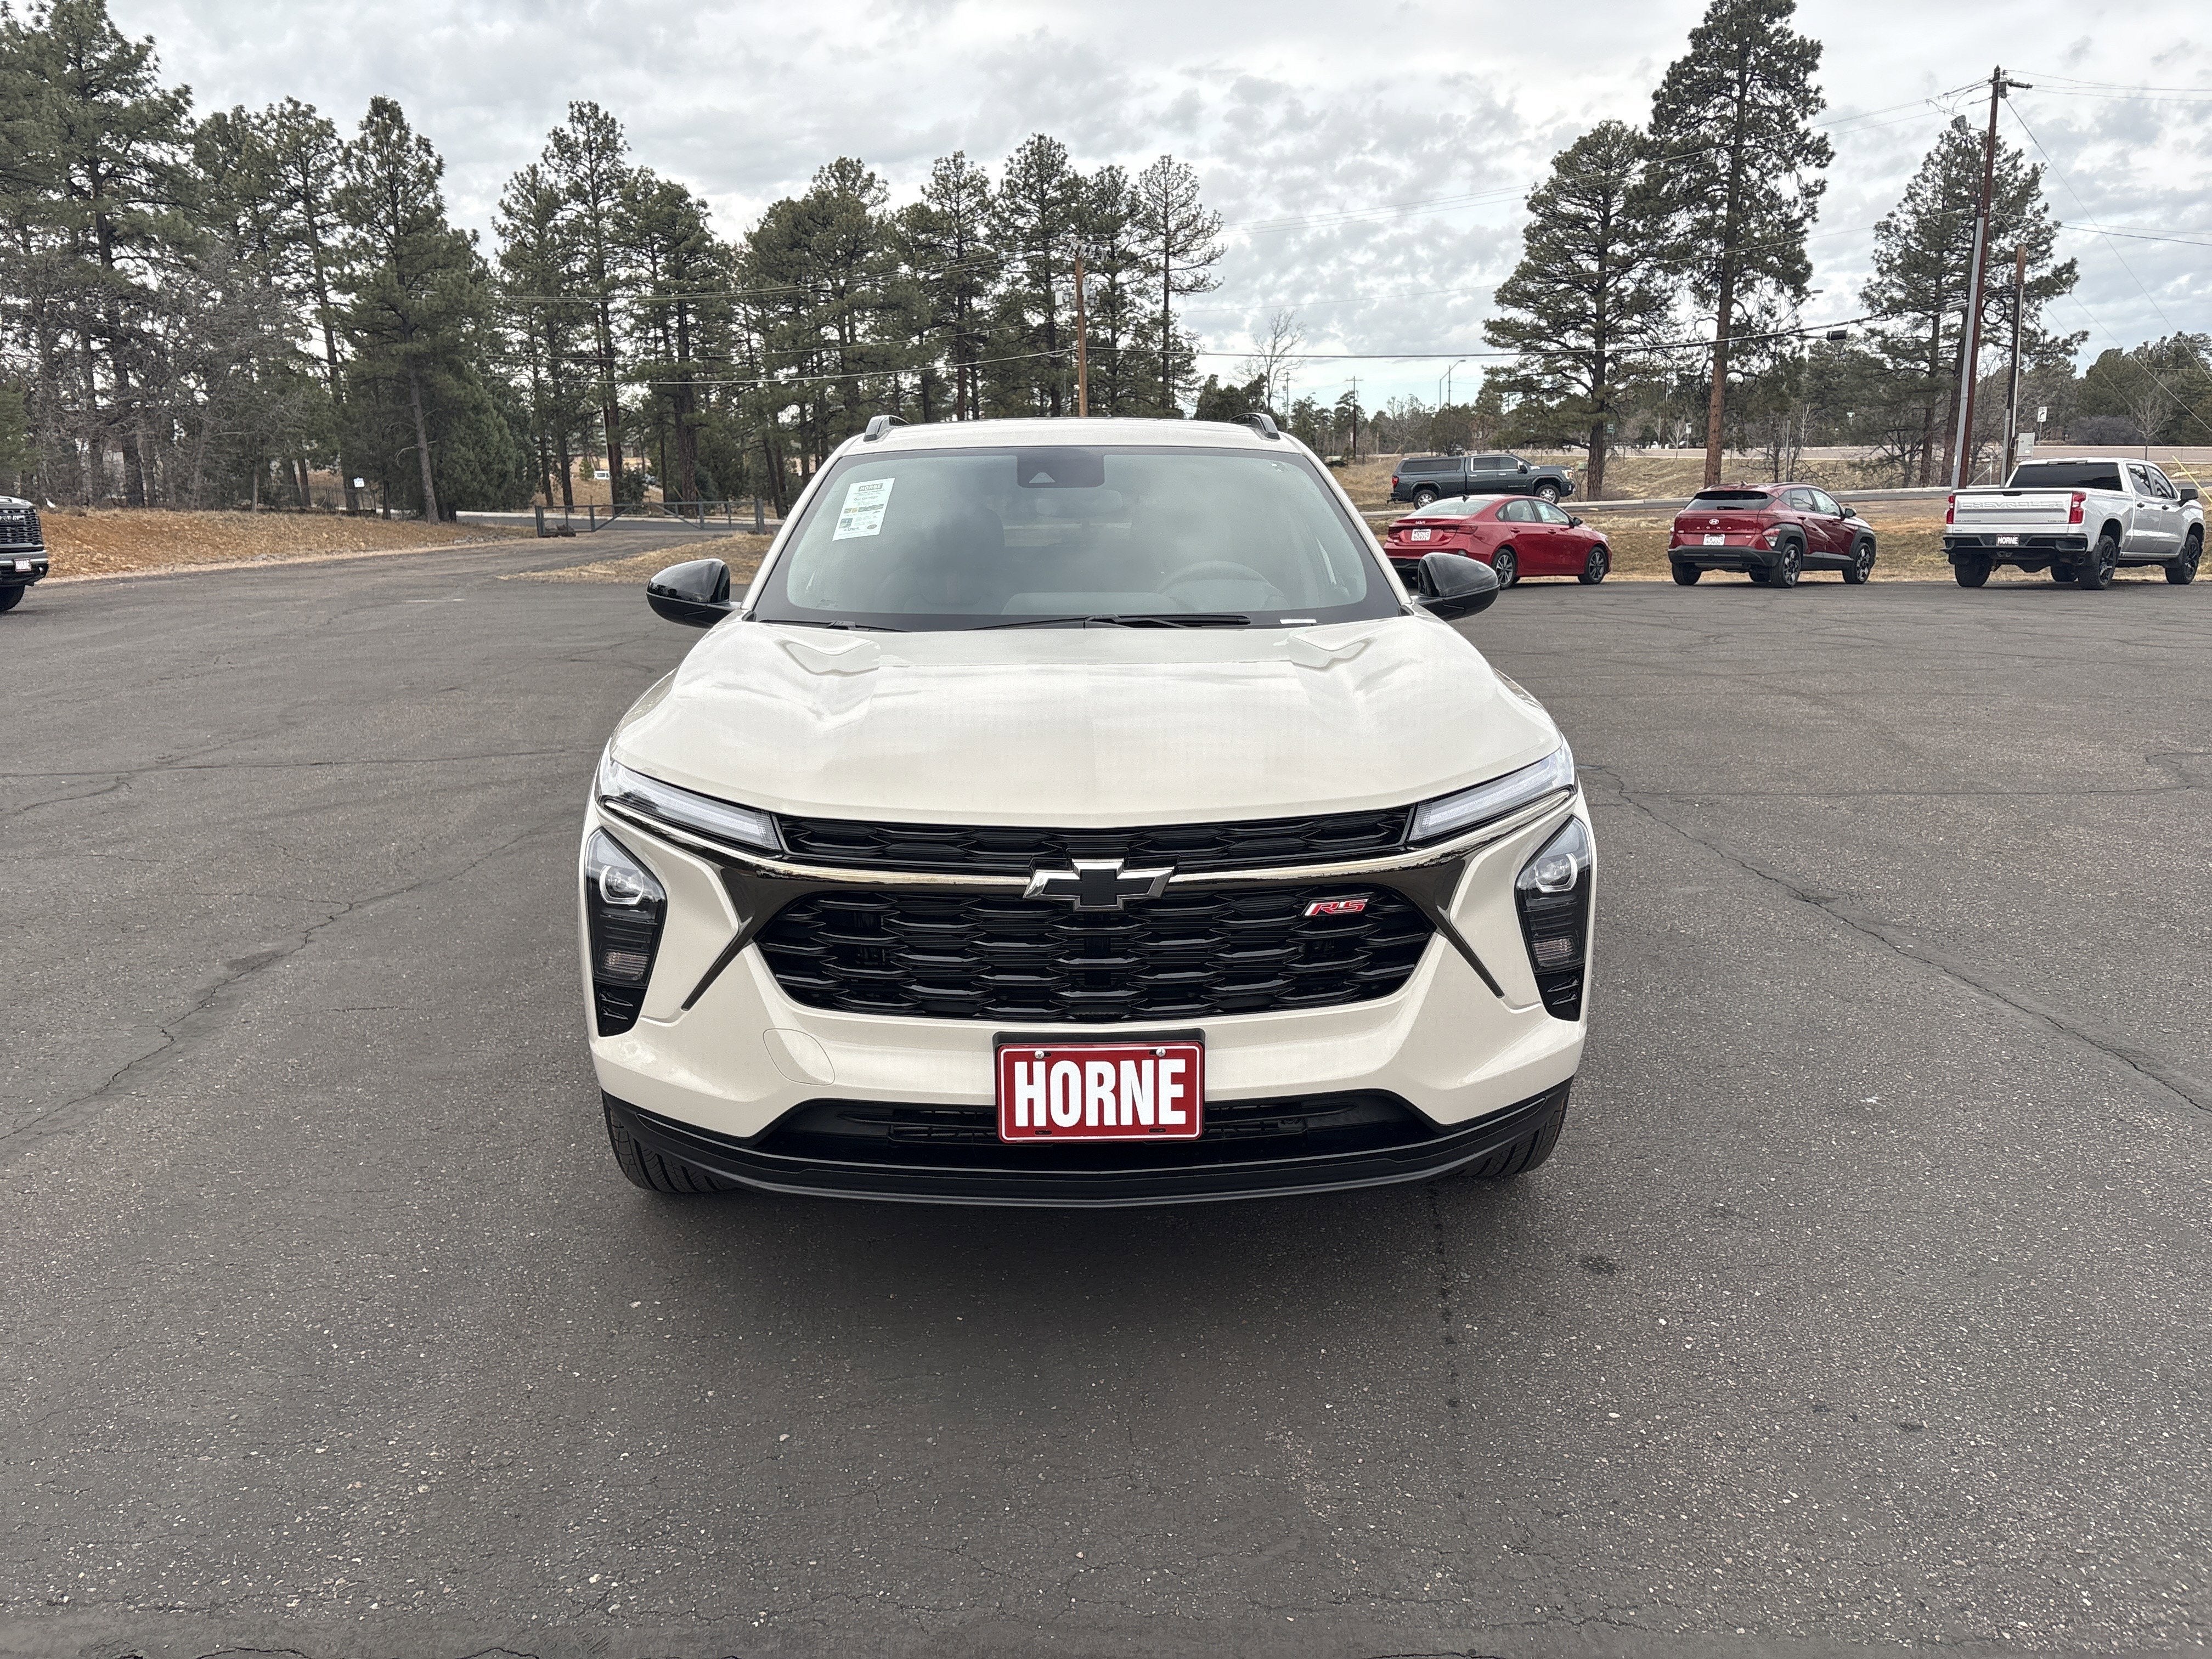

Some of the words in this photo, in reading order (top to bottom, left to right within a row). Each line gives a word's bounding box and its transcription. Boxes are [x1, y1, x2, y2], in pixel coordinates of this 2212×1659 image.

[1997, 537, 2018, 545] HORNE
[1304, 899, 1369, 916] RS
[1014, 1059, 1186, 1127] HORNE
